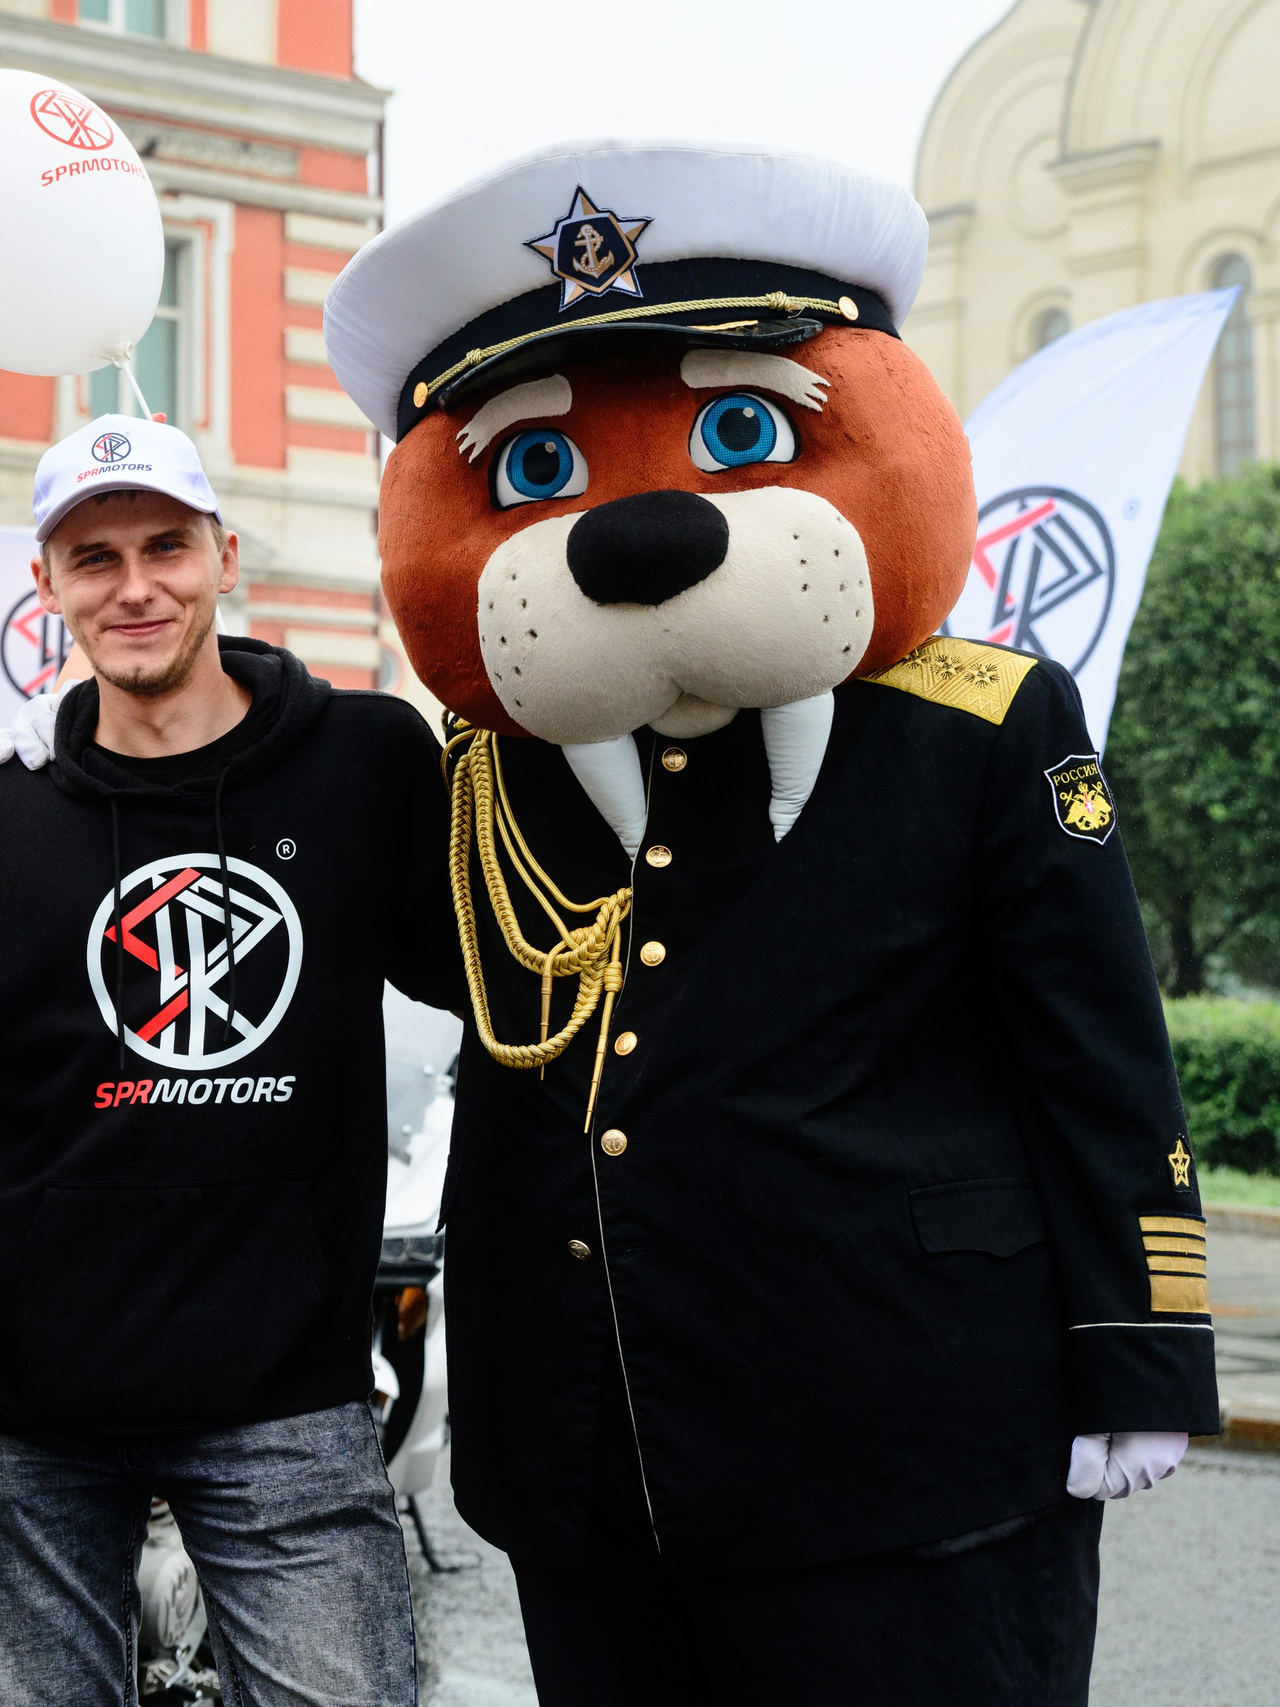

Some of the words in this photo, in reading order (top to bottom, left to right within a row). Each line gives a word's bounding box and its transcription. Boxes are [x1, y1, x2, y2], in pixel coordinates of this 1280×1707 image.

[41, 158, 146, 187] SPRMOTORS
[77, 463, 153, 483] SPRMOTORS
[1052, 763, 1099, 787] РОССИЯ
[94, 1075, 297, 1110] SPRMOTORS
